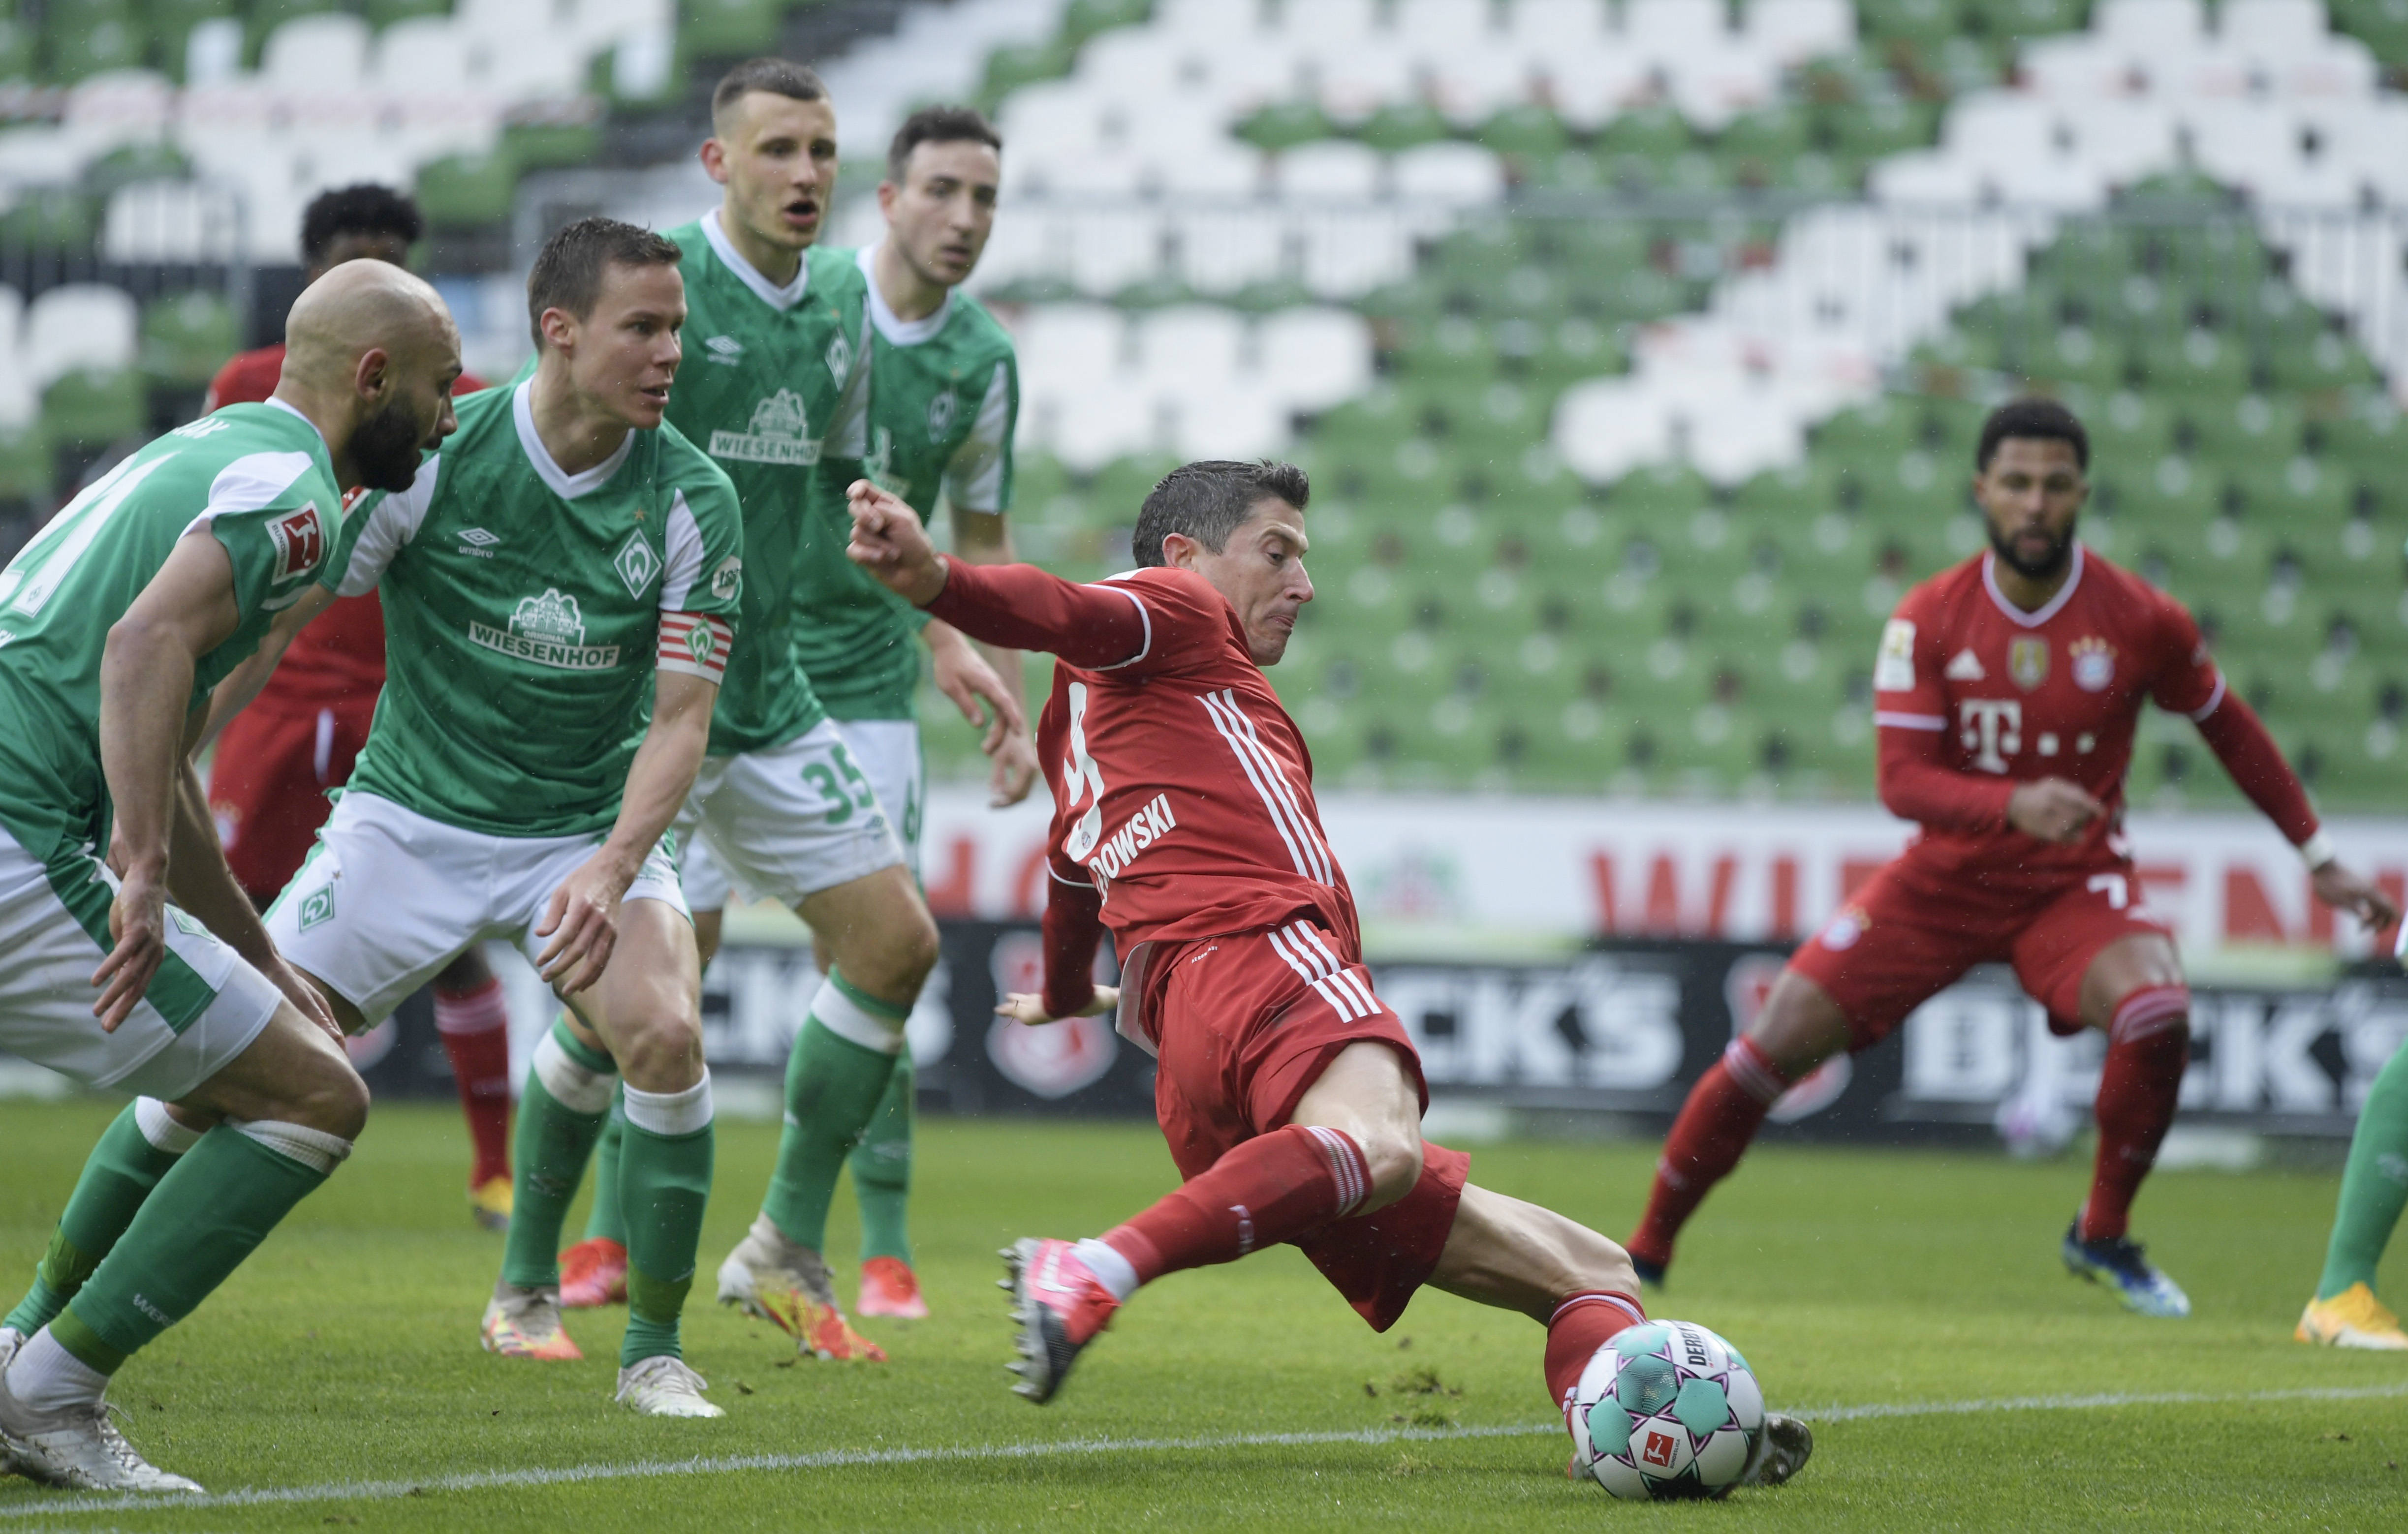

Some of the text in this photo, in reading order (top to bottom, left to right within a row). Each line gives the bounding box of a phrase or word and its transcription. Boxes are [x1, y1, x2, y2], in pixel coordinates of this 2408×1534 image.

[459, 546, 494, 558] umbro
[474, 625, 616, 666] WIESENHOF
[523, 630, 567, 644] ORIGINAL
[800, 742, 874, 825] 35
[2087, 873, 2127, 910] 7
